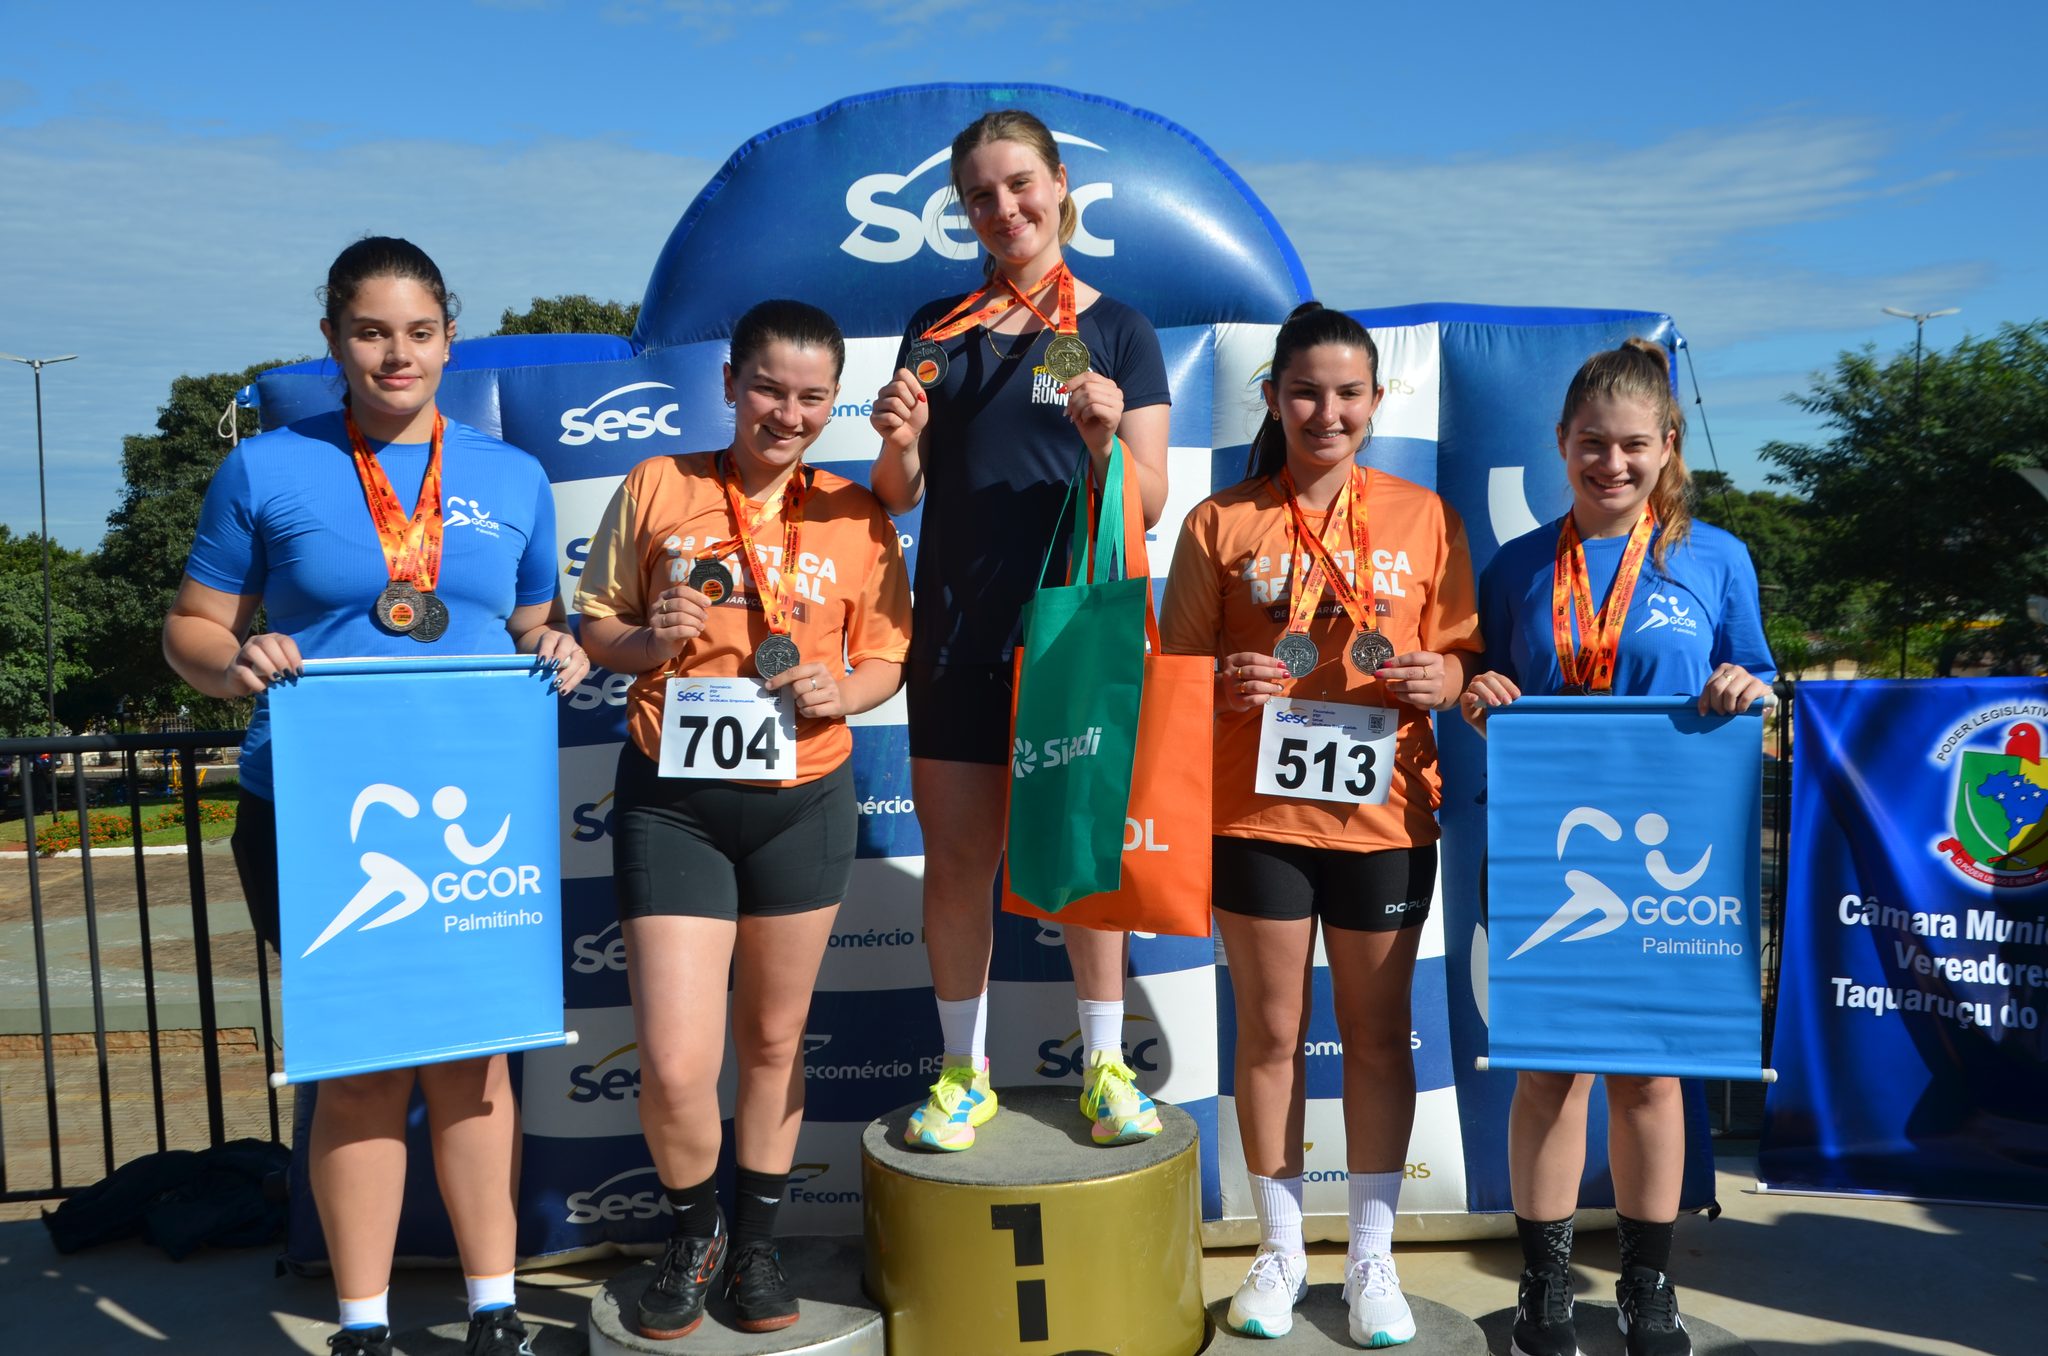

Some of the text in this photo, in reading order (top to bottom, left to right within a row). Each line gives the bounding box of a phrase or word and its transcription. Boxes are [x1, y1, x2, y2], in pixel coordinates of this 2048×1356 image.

[840, 173, 1114, 263] Sec
[1388, 379, 1415, 395] RS
[1670, 616, 1697, 629] GCOR
[680, 715, 780, 770] 704
[1937, 706, 2048, 761] PODER LEGISLATIV
[1275, 737, 1376, 797] 513
[431, 865, 542, 904] GCOR
[444, 908, 543, 933] Palmitinho
[1631, 895, 1742, 926] GCOR
[1838, 893, 2048, 945] Câmara Muni
[827, 928, 914, 948] omércio
[1643, 937, 1743, 956] Palmitinho
[571, 934, 627, 974] Se
[1831, 977, 2038, 1029] Taquaruçu do
[804, 1060, 912, 1079] ecomércio
[1404, 1162, 1431, 1180] RS
[790, 1187, 861, 1204] Fecom
